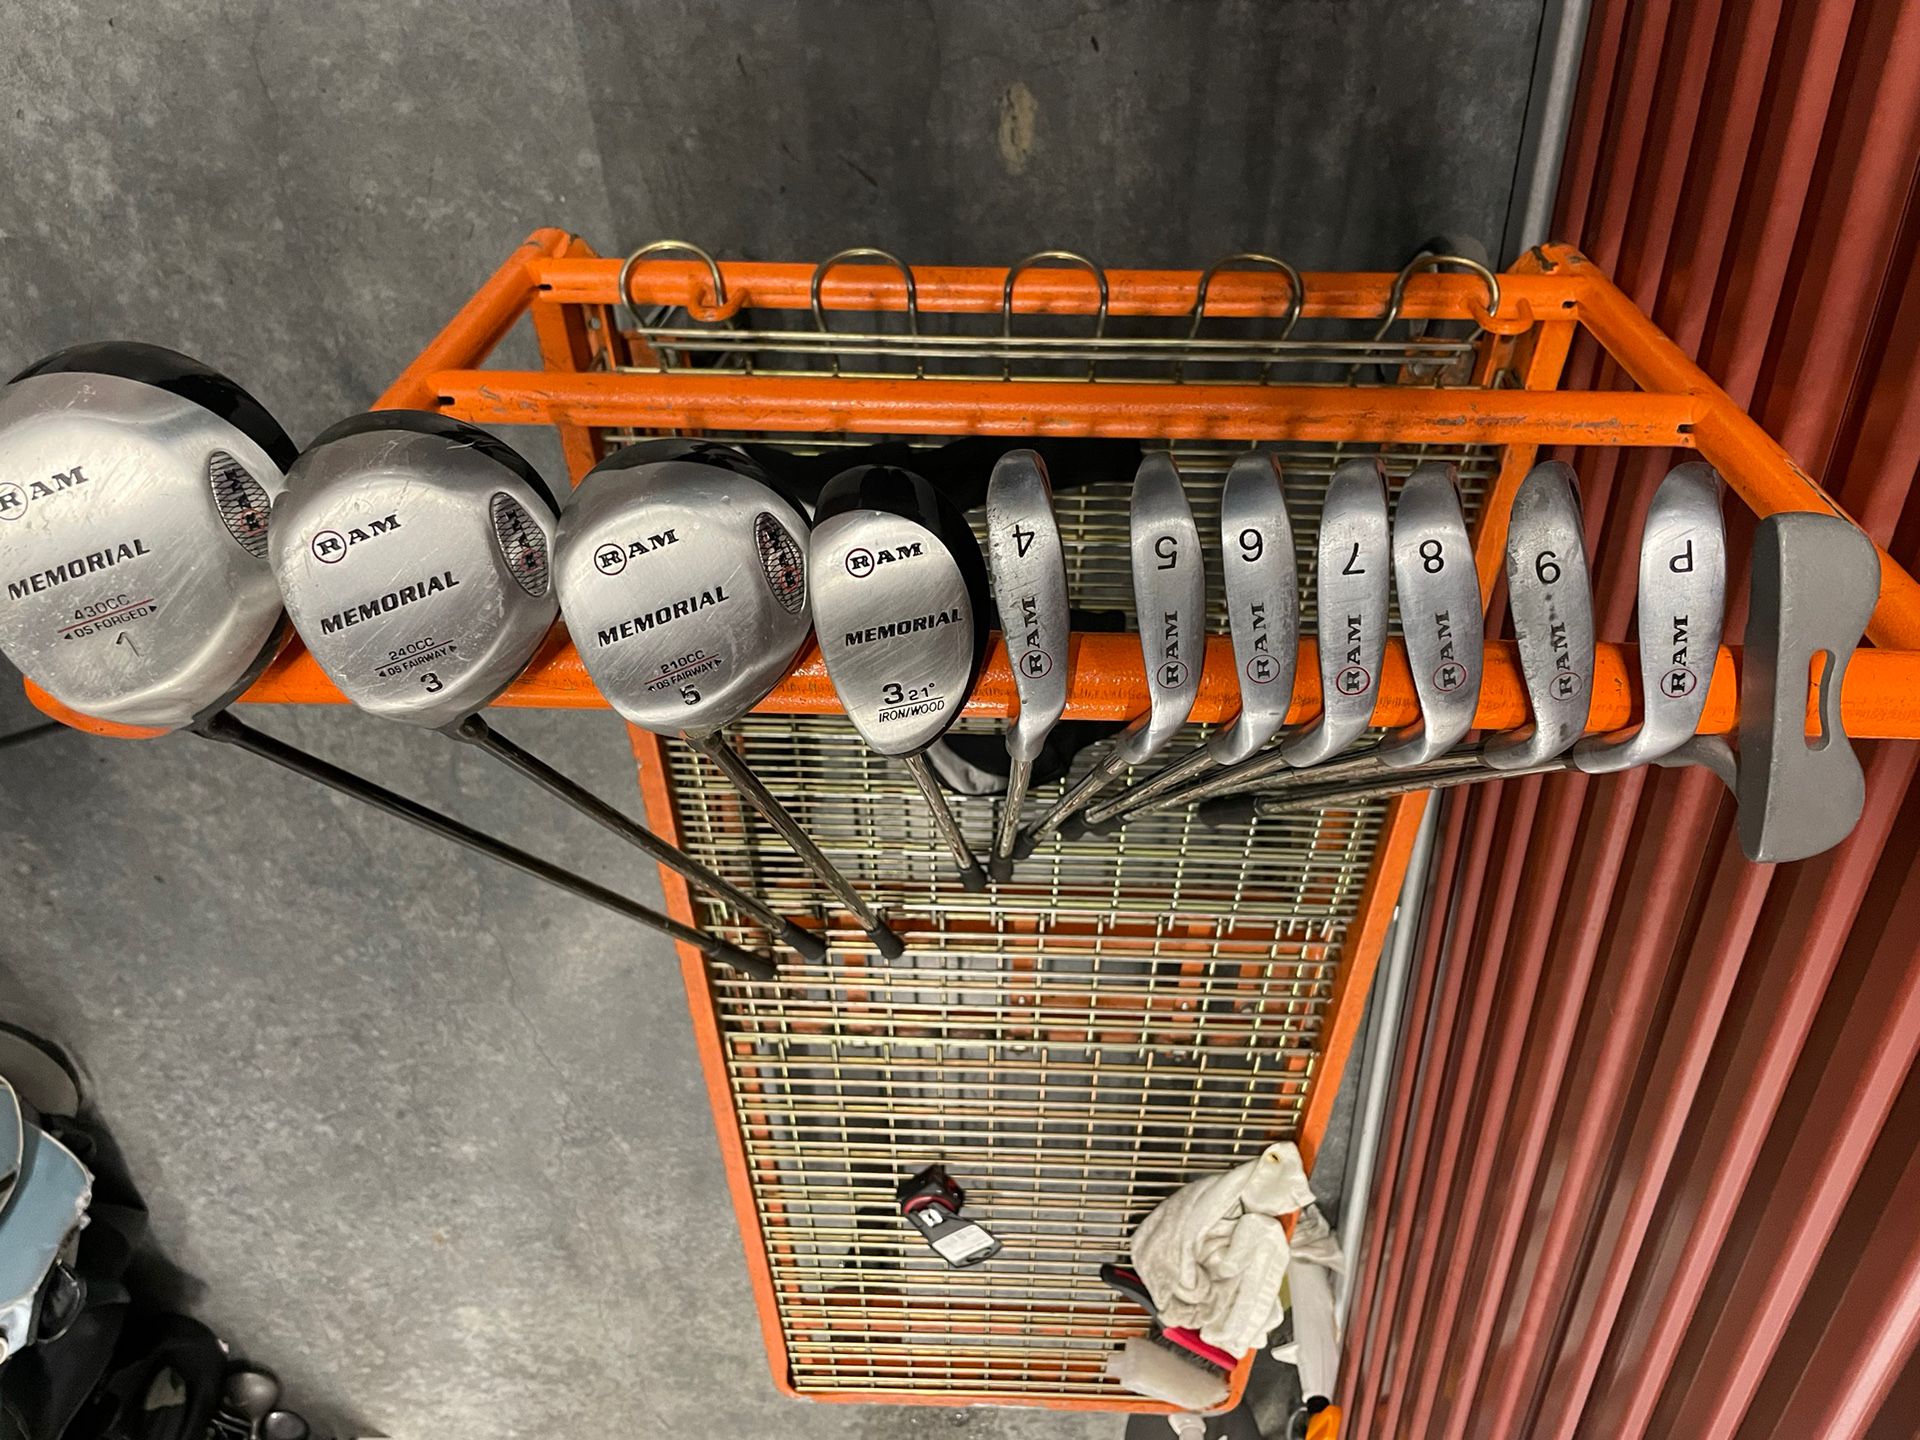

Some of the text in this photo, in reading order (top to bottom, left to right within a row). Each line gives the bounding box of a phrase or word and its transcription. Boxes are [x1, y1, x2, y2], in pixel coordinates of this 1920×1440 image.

[0, 466, 89, 516] RAM
[313, 514, 401, 561] RAM
[595, 529, 679, 574] RAM
[1012, 524, 1035, 558] 4
[1154, 535, 1178, 570] 5
[1239, 528, 1264, 562] 6
[8, 539, 150, 600] MEMORIAL
[846, 542, 923, 576] RAM
[1341, 542, 1366, 576] 7
[1419, 539, 1445, 574] 8
[1535, 550, 1561, 584] 9
[1669, 540, 1693, 574] P
[74, 594, 130, 619] 430CC
[94, 607, 148, 631] FORGED
[321, 571, 459, 635] MEMORIAL
[598, 586, 729, 647] MEMORIAL
[845, 608, 963, 647] MEMORIAL
[1021, 596, 1048, 677] RAM
[1249, 602, 1274, 681] RAM
[388, 637, 435, 660] 240CC
[403, 648, 447, 670] FAIRWAY
[660, 650, 705, 674] 210CC
[1161, 611, 1183, 687] RAM
[1342, 614, 1366, 693] RAM
[1434, 609, 1462, 690] RAM
[1550, 621, 1578, 698] RAM
[1666, 614, 1692, 696] RAM
[420, 672, 443, 693] 3
[671, 661, 715, 684] FAIRWAY
[680, 684, 701, 706] 5
[882, 683, 904, 705] 3
[878, 700, 945, 723] IRON/WOOD
